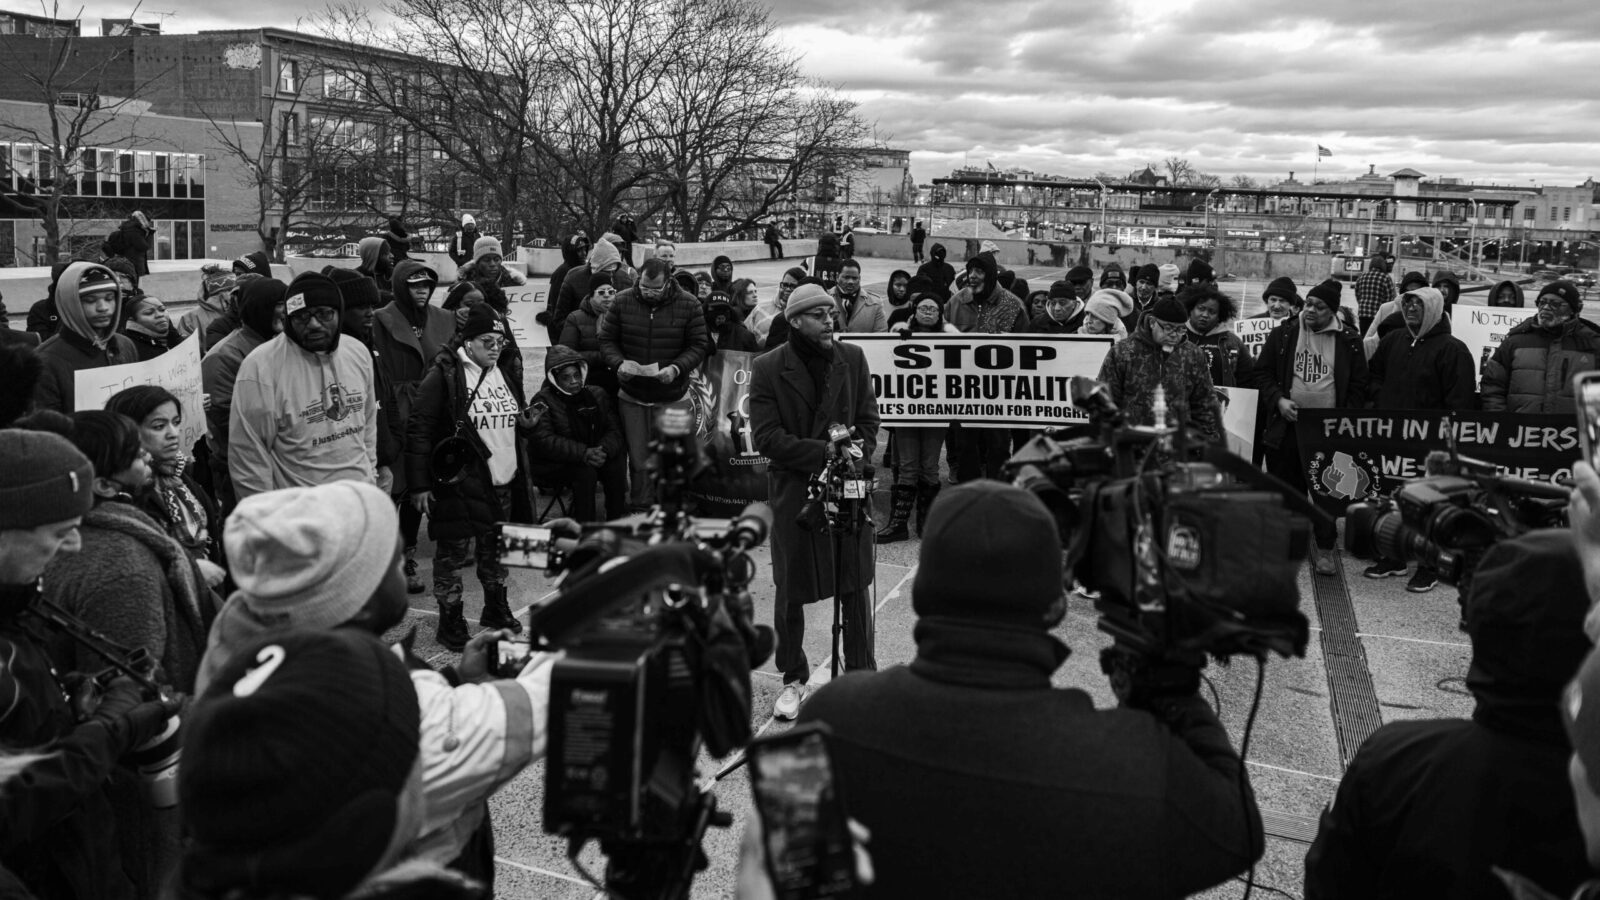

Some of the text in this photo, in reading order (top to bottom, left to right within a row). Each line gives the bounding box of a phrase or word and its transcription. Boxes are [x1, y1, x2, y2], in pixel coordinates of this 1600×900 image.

[1346, 261, 1363, 271] CAT
[1471, 310, 1490, 325] NO
[1236, 319, 1275, 333] IF YOU
[893, 344, 1057, 370] STOP
[870, 373, 1068, 401] OLICE BRUTALIT
[879, 403, 1089, 419] LE'S ORGANIZATION FOR PROGRE
[472, 413, 516, 430] MATTE
[1323, 417, 1394, 438] FAITH
[1402, 419, 1430, 440] IN
[1438, 417, 1500, 444] NEW
